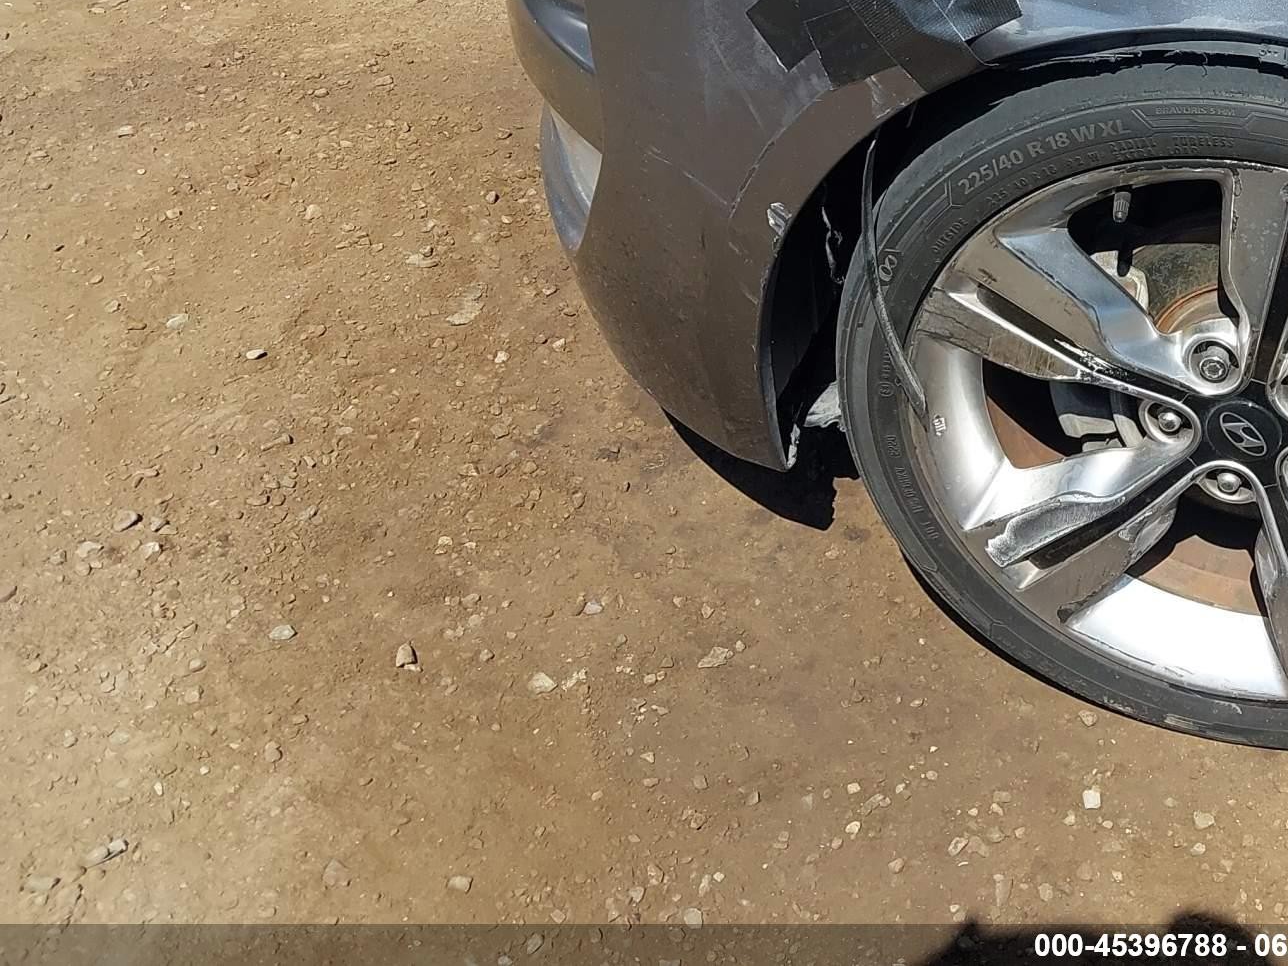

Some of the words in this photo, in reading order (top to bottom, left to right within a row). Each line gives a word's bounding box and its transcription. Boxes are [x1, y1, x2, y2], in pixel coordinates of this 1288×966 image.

[958, 149, 1024, 195] 225/40
[1026, 140, 1046, 158] R
[1045, 132, 1071, 151] 18
[1072, 123, 1097, 143] W
[1098, 119, 1132, 137] XL
[1172, 135, 1236, 148] TUBELESS
[931, 217, 969, 253] OUTSIDE
